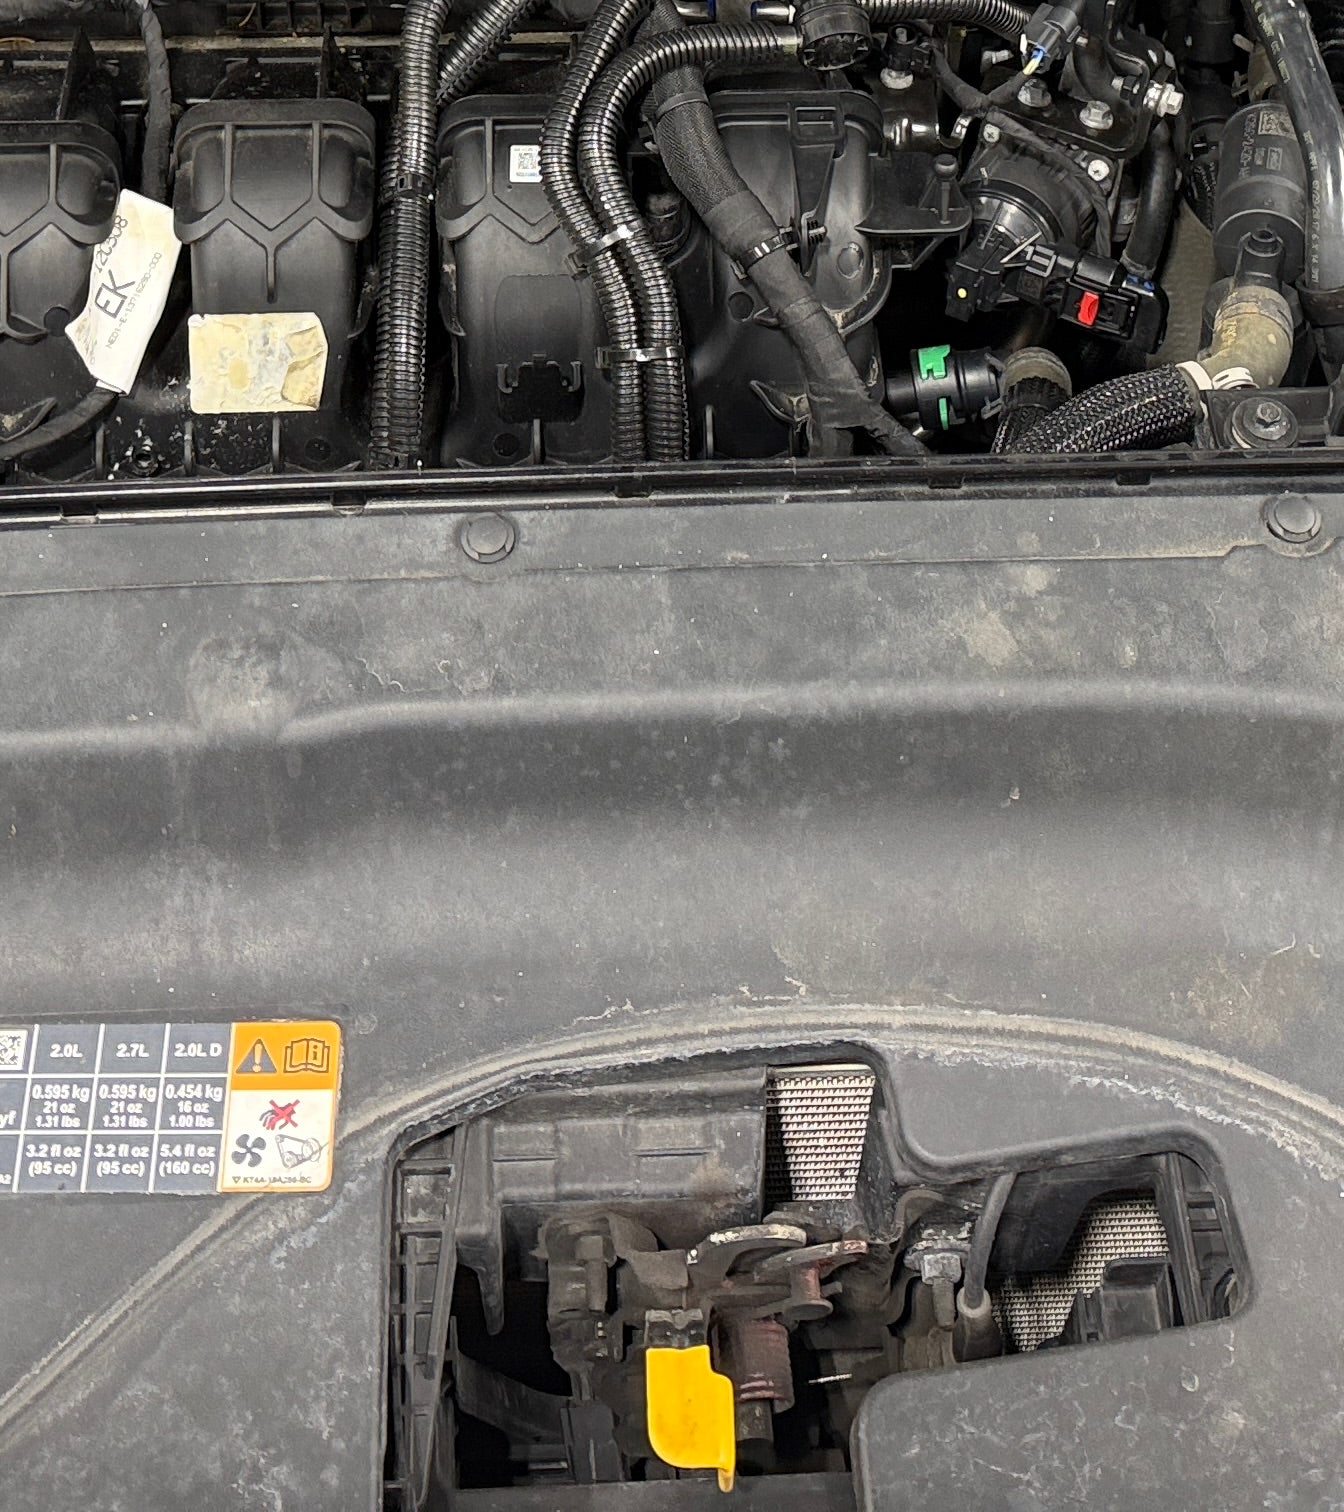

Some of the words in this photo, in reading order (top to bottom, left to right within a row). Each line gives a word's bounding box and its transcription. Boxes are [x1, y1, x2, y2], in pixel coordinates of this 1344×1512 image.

[94, 268, 136, 319] EK
[49, 1043, 84, 1058] 2.0L
[115, 1043, 150, 1058] 2.7L
[173, 1042, 207, 1057] 2.0L
[209, 1043, 223, 1057] D
[32, 1084, 70, 1099] 0.595
[71, 1083, 91, 1103] kg
[98, 1084, 137, 1099] 0.595
[138, 1083, 156, 1103] kg
[165, 1084, 204, 1099] 0.454
[205, 1083, 223, 1102] kg
[42, 1101, 59, 1114] 21
[59, 1102, 76, 1114] oz
[109, 1101, 125, 1114] 21
[126, 1102, 143, 1114] oz
[177, 1101, 194, 1114] 16
[195, 1102, 210, 1114] oz
[34, 1115, 60, 1128] 1.31
[60, 1115, 81, 1128] lbs
[102, 1115, 127, 1128] 1.31
[128, 1115, 148, 1128] lbs
[168, 1115, 194, 1128] 1.00
[195, 1115, 215, 1128] lbs
[25, 1144, 49, 1158] 3.2
[50, 1144, 62, 1157] fl
[63, 1145, 82, 1158] oz
[93, 1144, 117, 1158] 3.2
[117, 1144, 129, 1157] fl
[131, 1145, 150, 1158] oz
[159, 1144, 183, 1158] 5.4
[184, 1144, 195, 1157] fl
[197, 1145, 217, 1158] oz
[28, 1161, 53, 1178] (95
[53, 1161, 78, 1178] cc)
[96, 1161, 120, 1178] (95
[121, 1161, 146, 1178] cc)
[158, 1161, 190, 1178] (160
[192, 1161, 216, 1178] cc)
